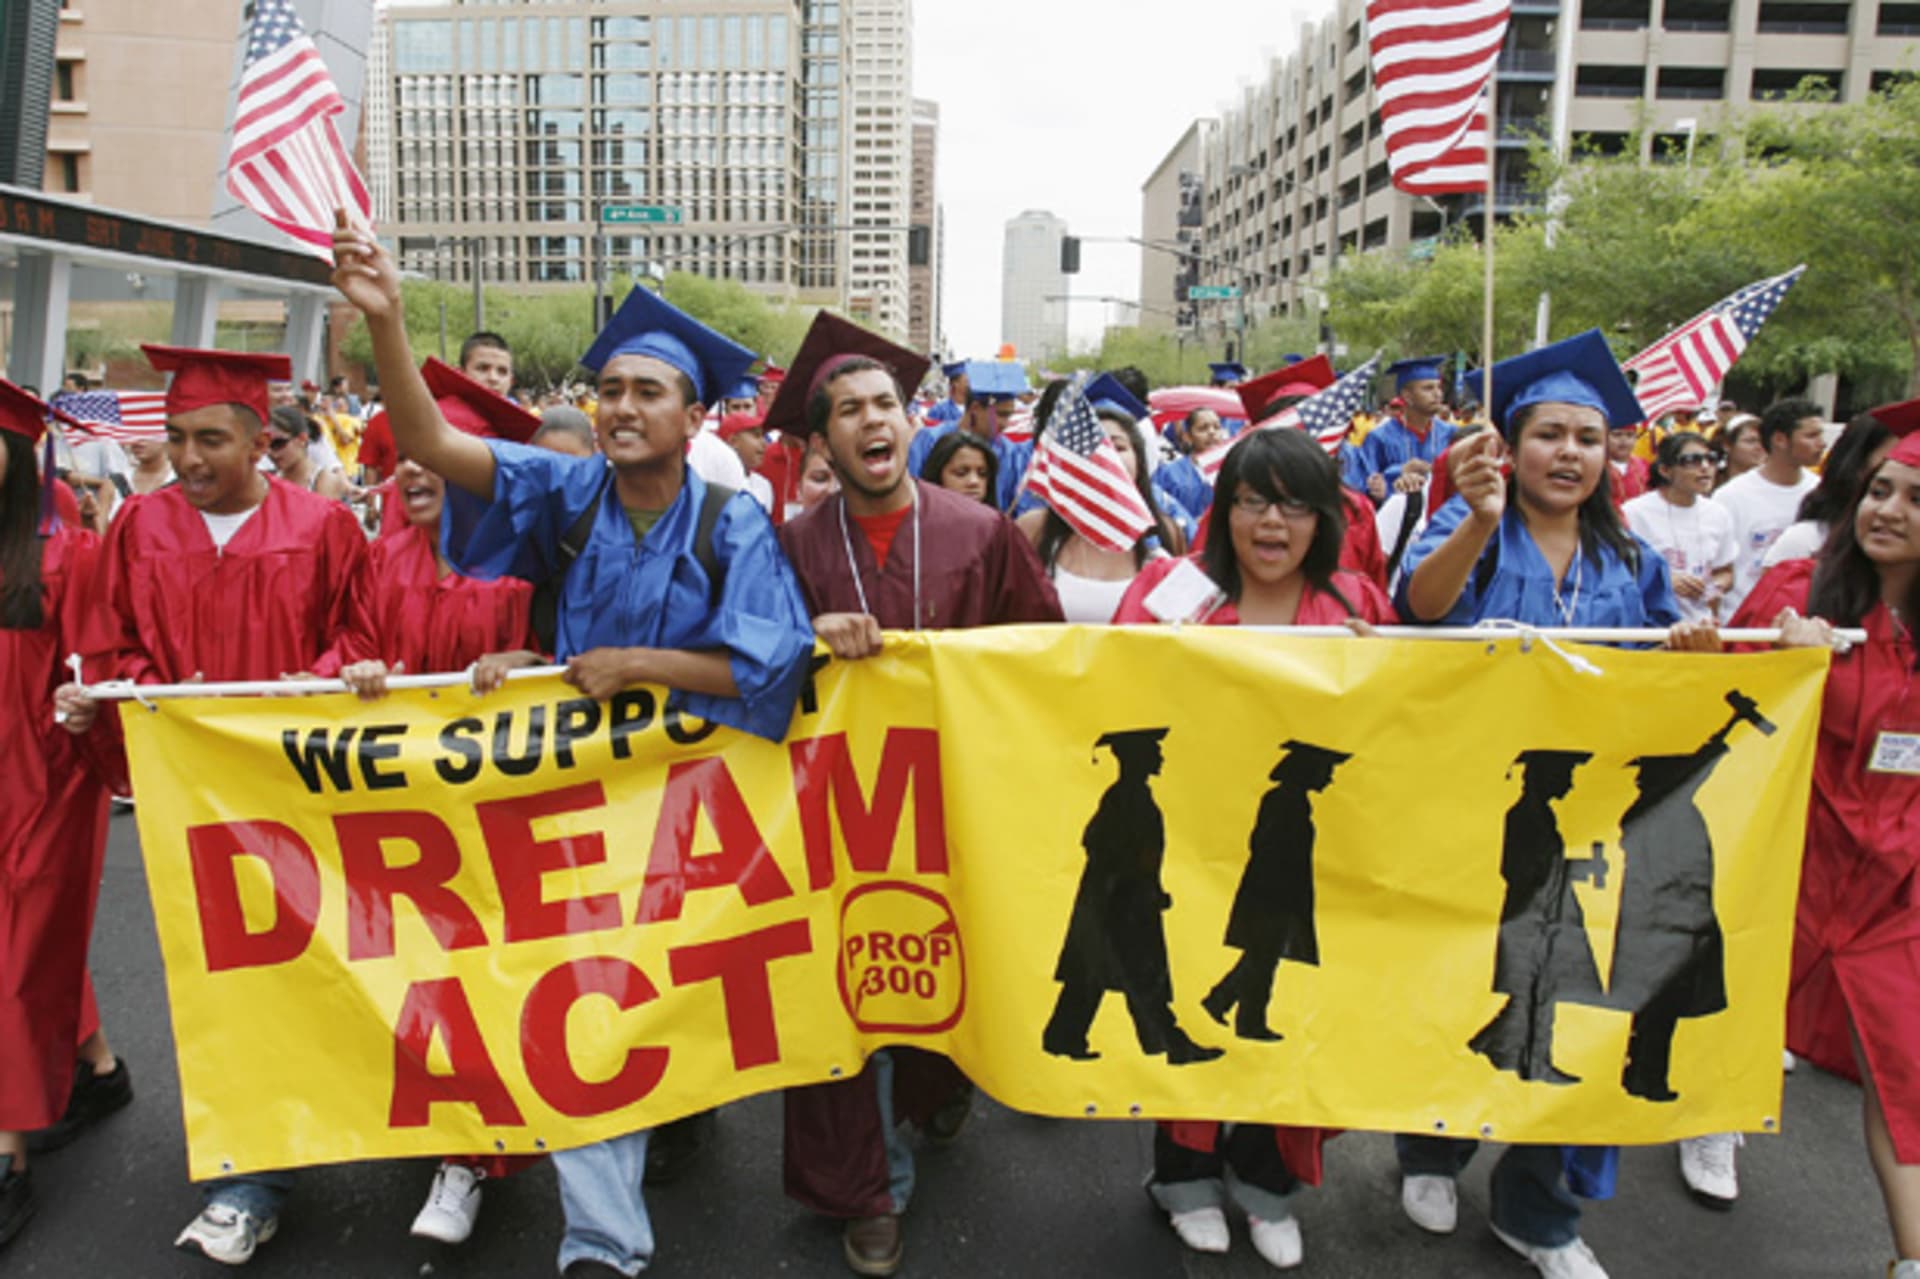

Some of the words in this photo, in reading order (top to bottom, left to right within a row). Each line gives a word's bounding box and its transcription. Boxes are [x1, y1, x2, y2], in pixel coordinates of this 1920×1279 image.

[283, 724, 408, 794] WE
[435, 653, 831, 785] SUPPOT
[187, 727, 949, 972] DREAM
[846, 931, 952, 970] PROP
[863, 965, 937, 999] 300
[389, 918, 813, 1129] ACT
